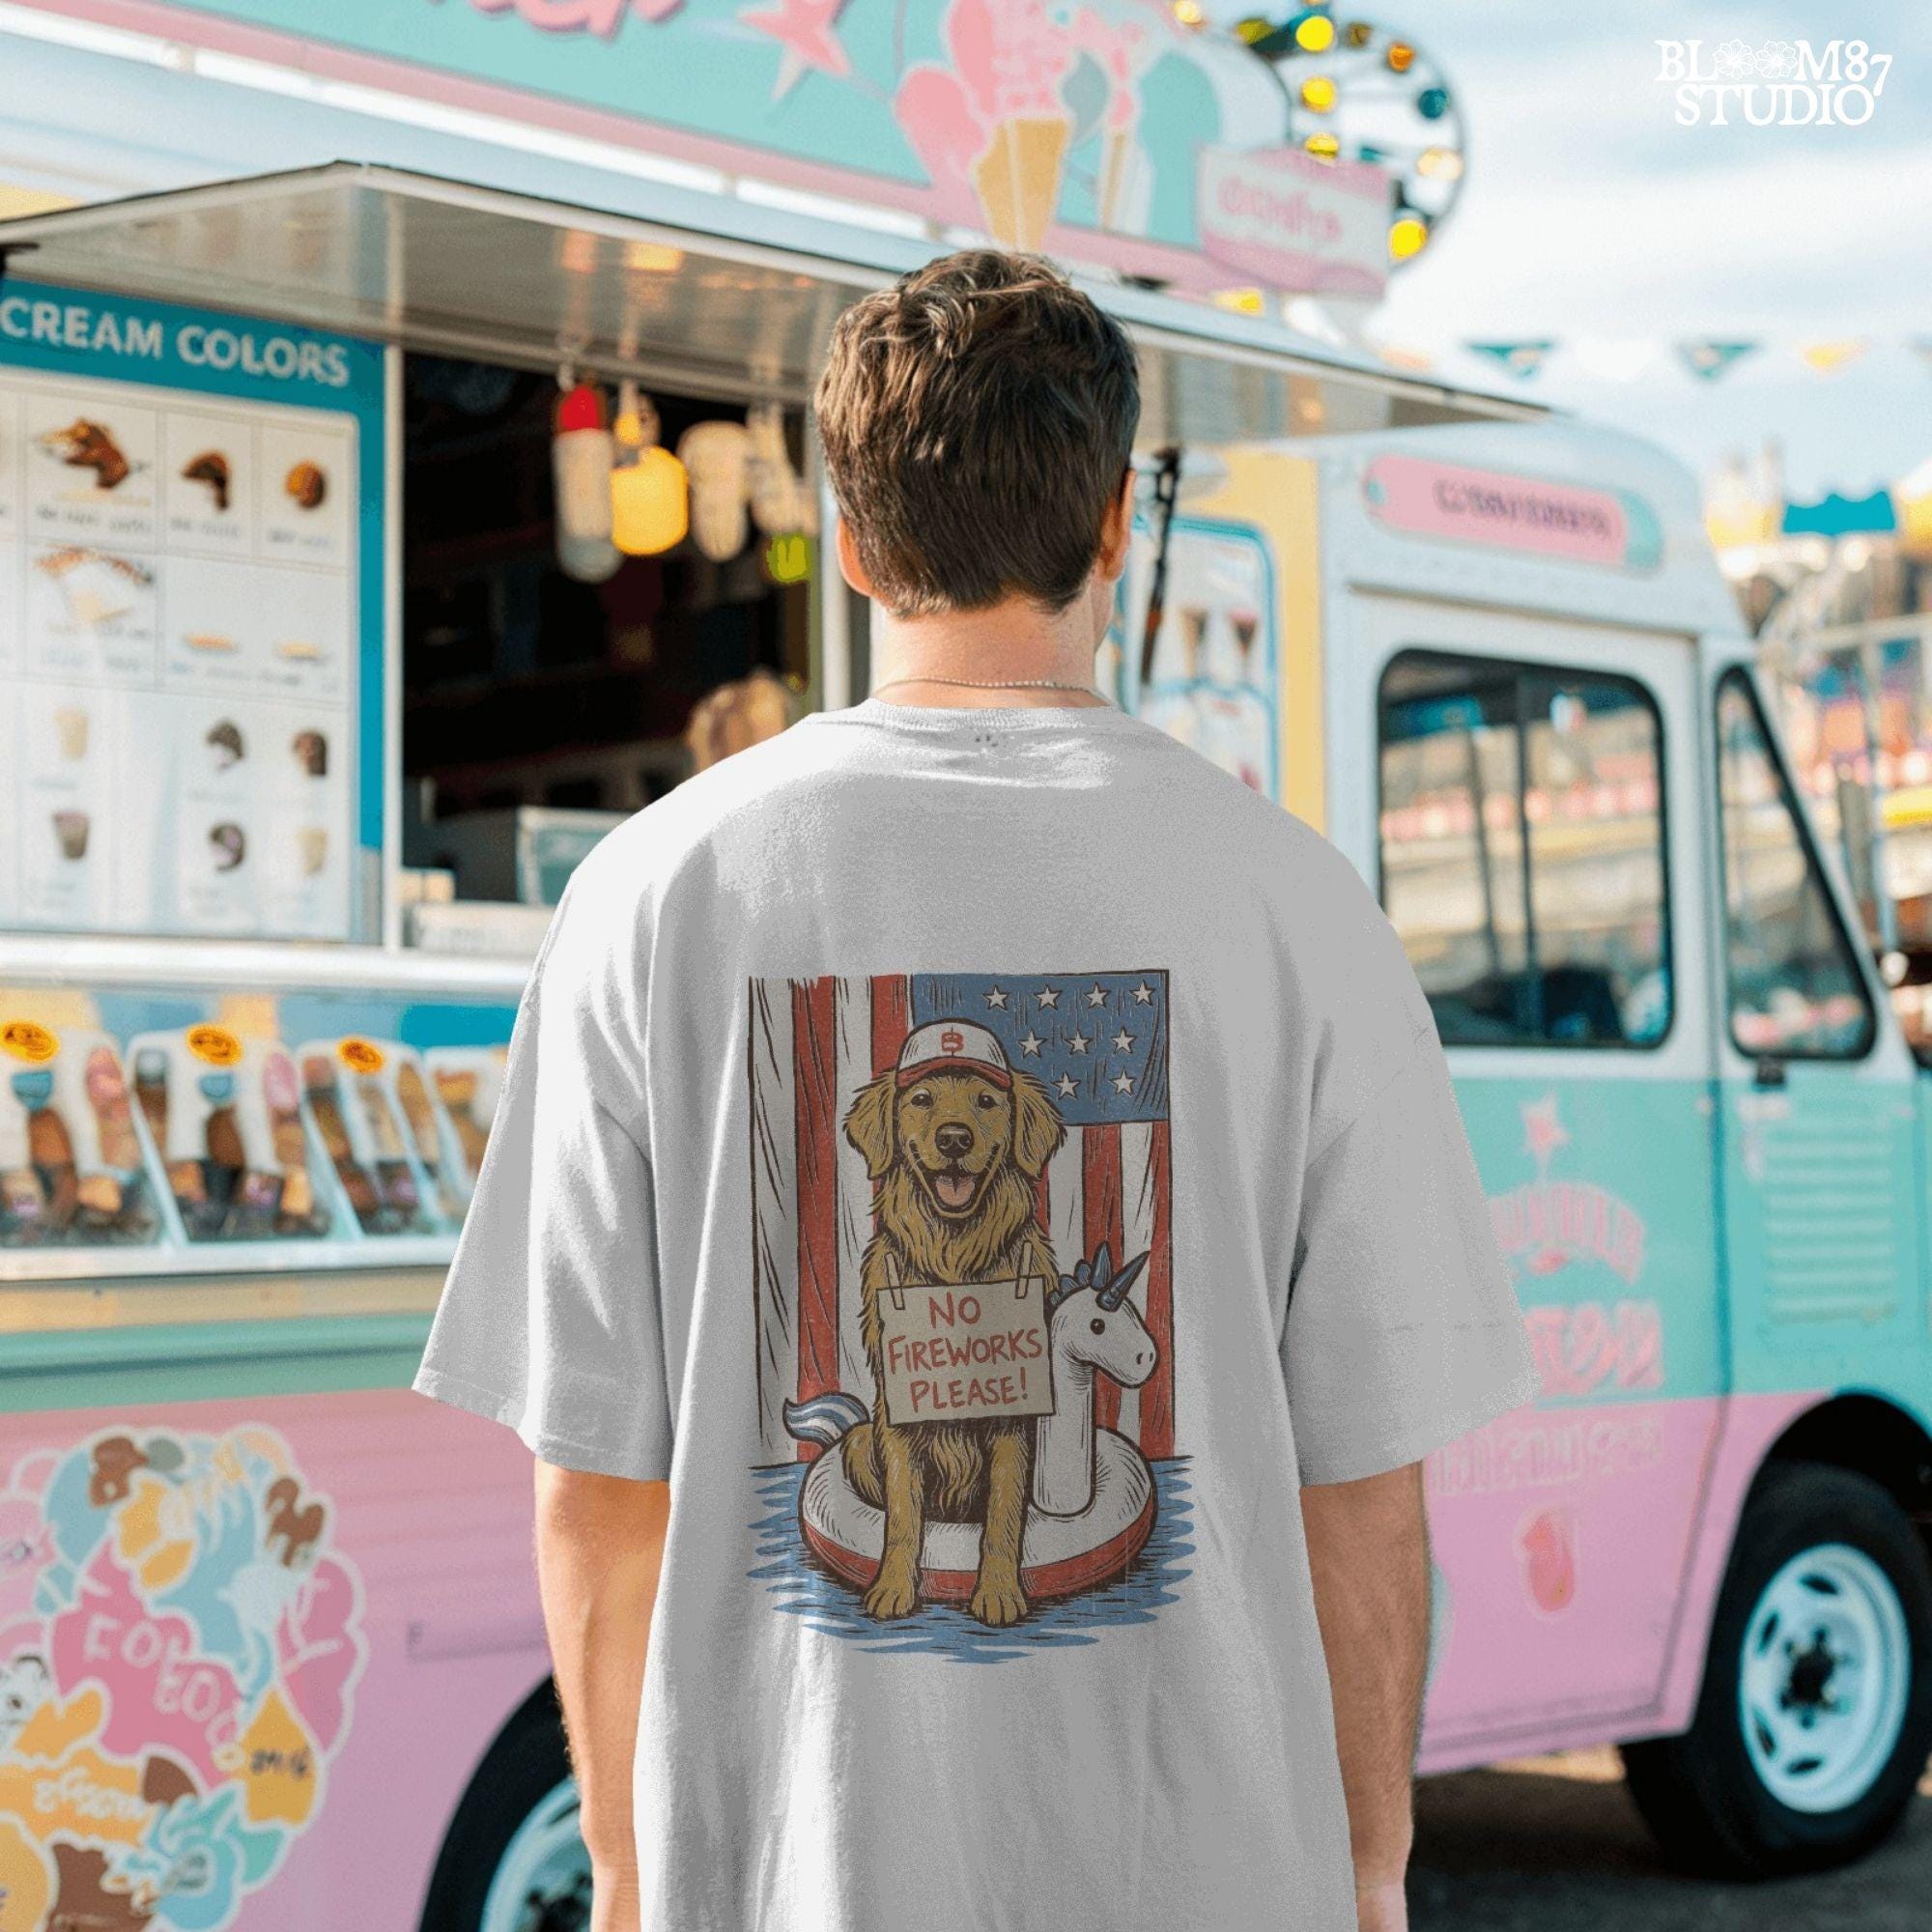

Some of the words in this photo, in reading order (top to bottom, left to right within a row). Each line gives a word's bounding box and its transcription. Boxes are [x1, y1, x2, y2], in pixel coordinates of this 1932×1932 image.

[0, 296, 164, 360] CREAM
[176, 325, 350, 387] COLORS
[941, 1032, 964, 1052] B
[928, 1292, 981, 1329] NO
[888, 1328, 1043, 1375] FIREWORKS
[910, 1366, 1029, 1412] PLEASE!
